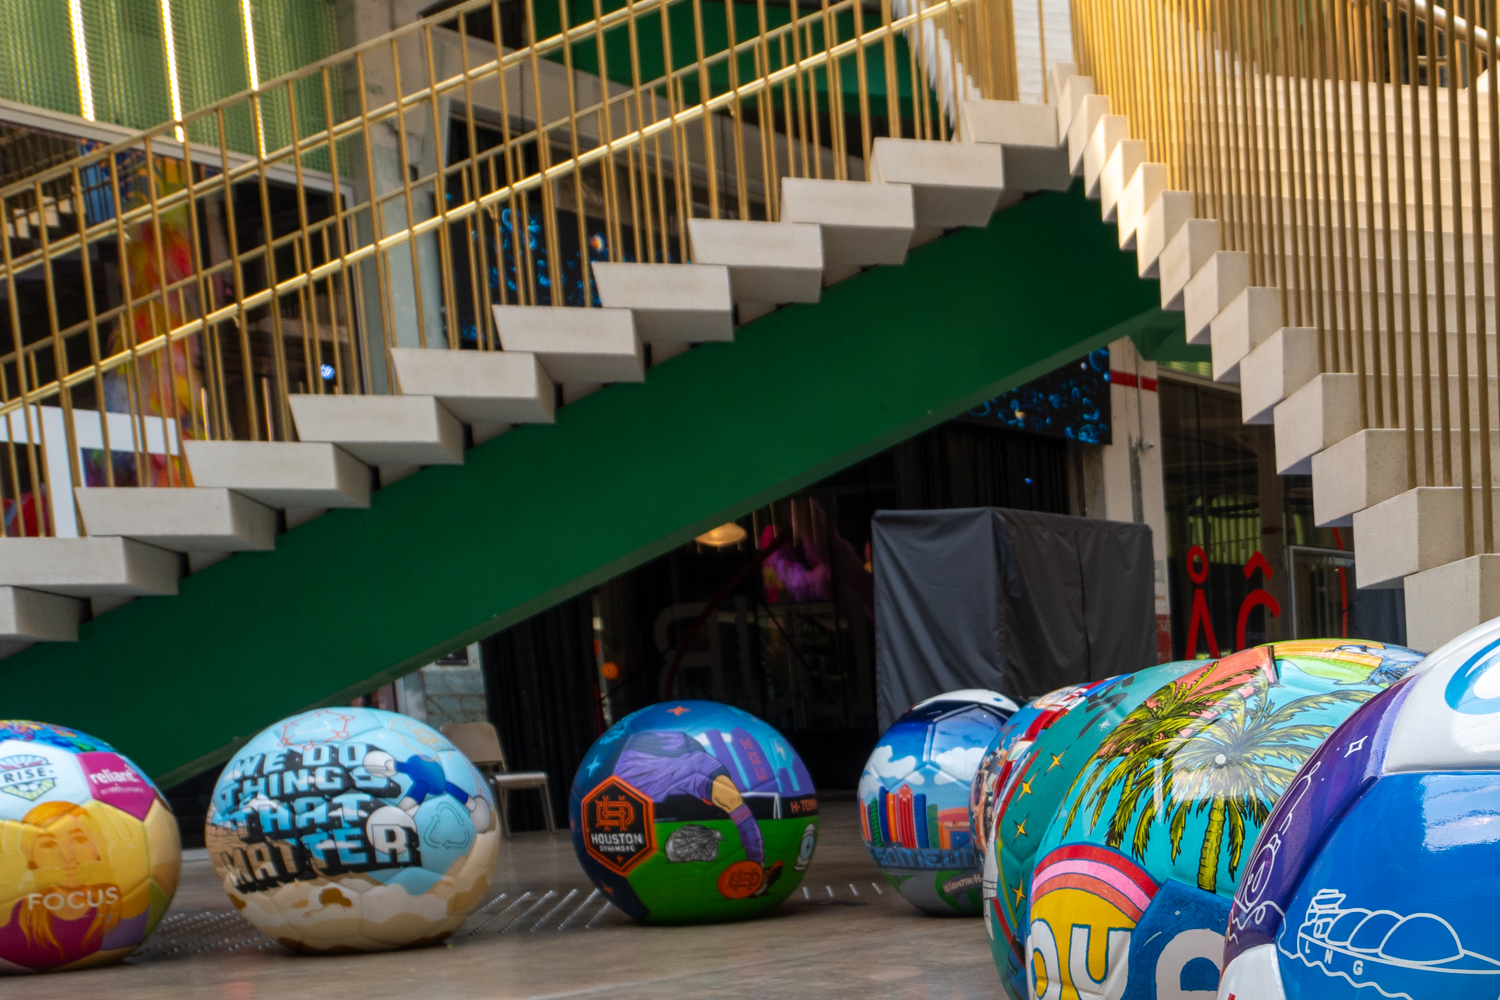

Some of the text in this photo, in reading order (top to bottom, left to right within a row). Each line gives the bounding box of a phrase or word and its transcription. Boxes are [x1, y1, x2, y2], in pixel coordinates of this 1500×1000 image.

[233, 742, 367, 778] WE DO
[3, 767, 47, 784] RISE
[89, 768, 140, 785] reliant
[220, 766, 389, 803] THINGS
[213, 793, 373, 838] THAT
[591, 833, 643, 845] HOUSTON
[220, 824, 413, 886] MATTER
[28, 887, 119, 911] FOCUS
